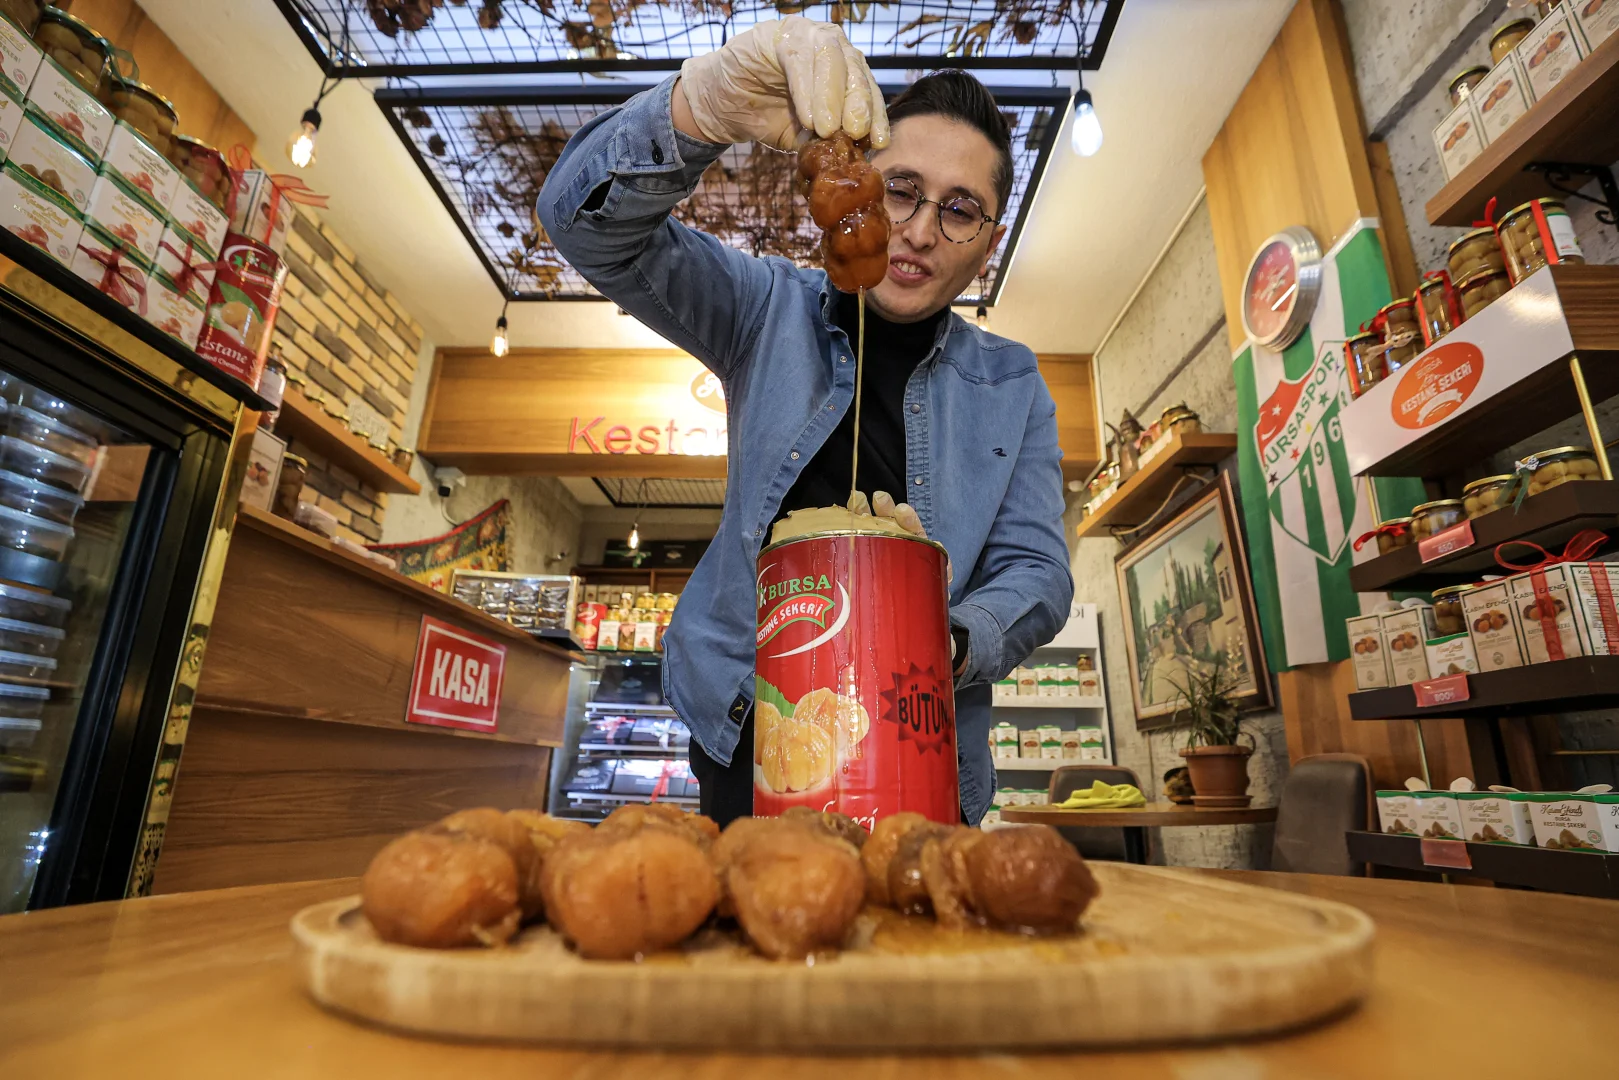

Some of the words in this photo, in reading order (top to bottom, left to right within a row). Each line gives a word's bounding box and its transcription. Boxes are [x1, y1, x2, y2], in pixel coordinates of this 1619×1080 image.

[199, 341, 248, 364] estane
[1400, 383, 1439, 415] KESTANE
[768, 574, 832, 600] BURSA
[429, 648, 490, 707] KASA
[898, 683, 949, 735] BÜTÜN
